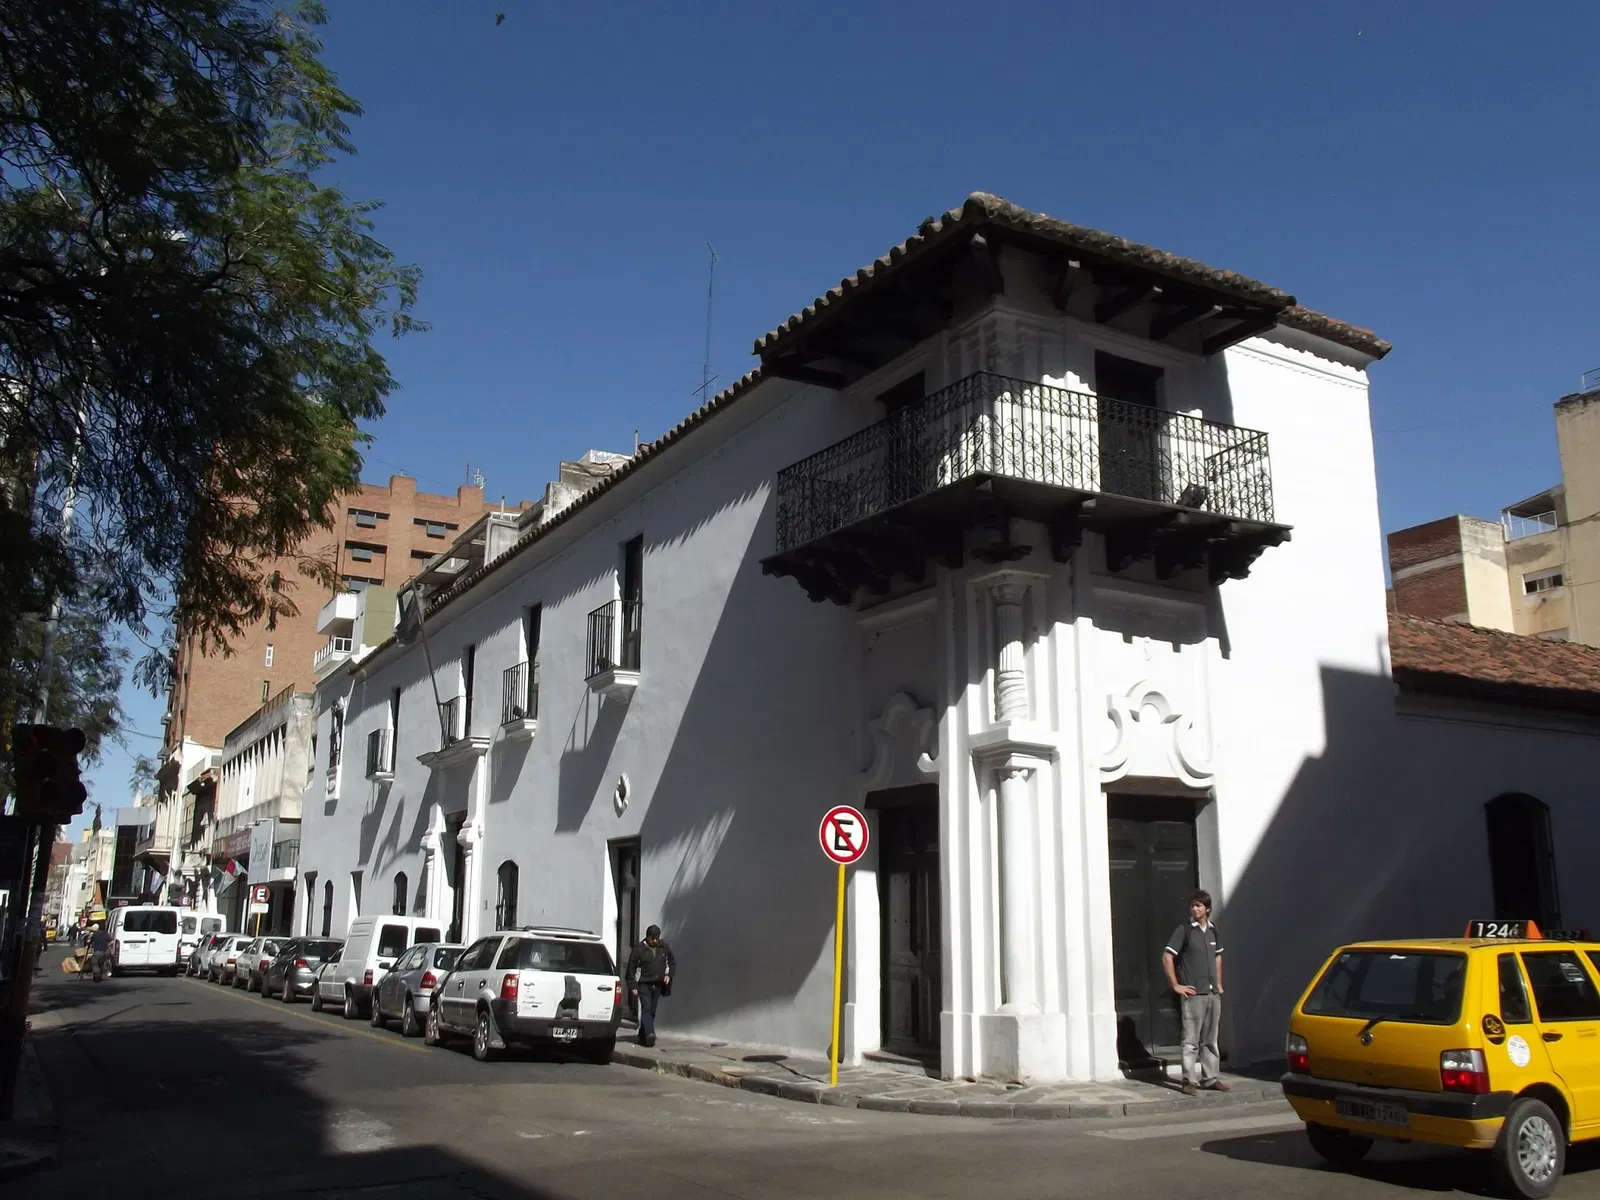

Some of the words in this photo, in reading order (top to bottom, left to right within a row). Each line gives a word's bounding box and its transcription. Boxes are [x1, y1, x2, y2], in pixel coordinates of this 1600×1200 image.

[834, 819, 854, 851] E
[256, 888, 266, 900] E
[1477, 922, 1520, 938] 1246
